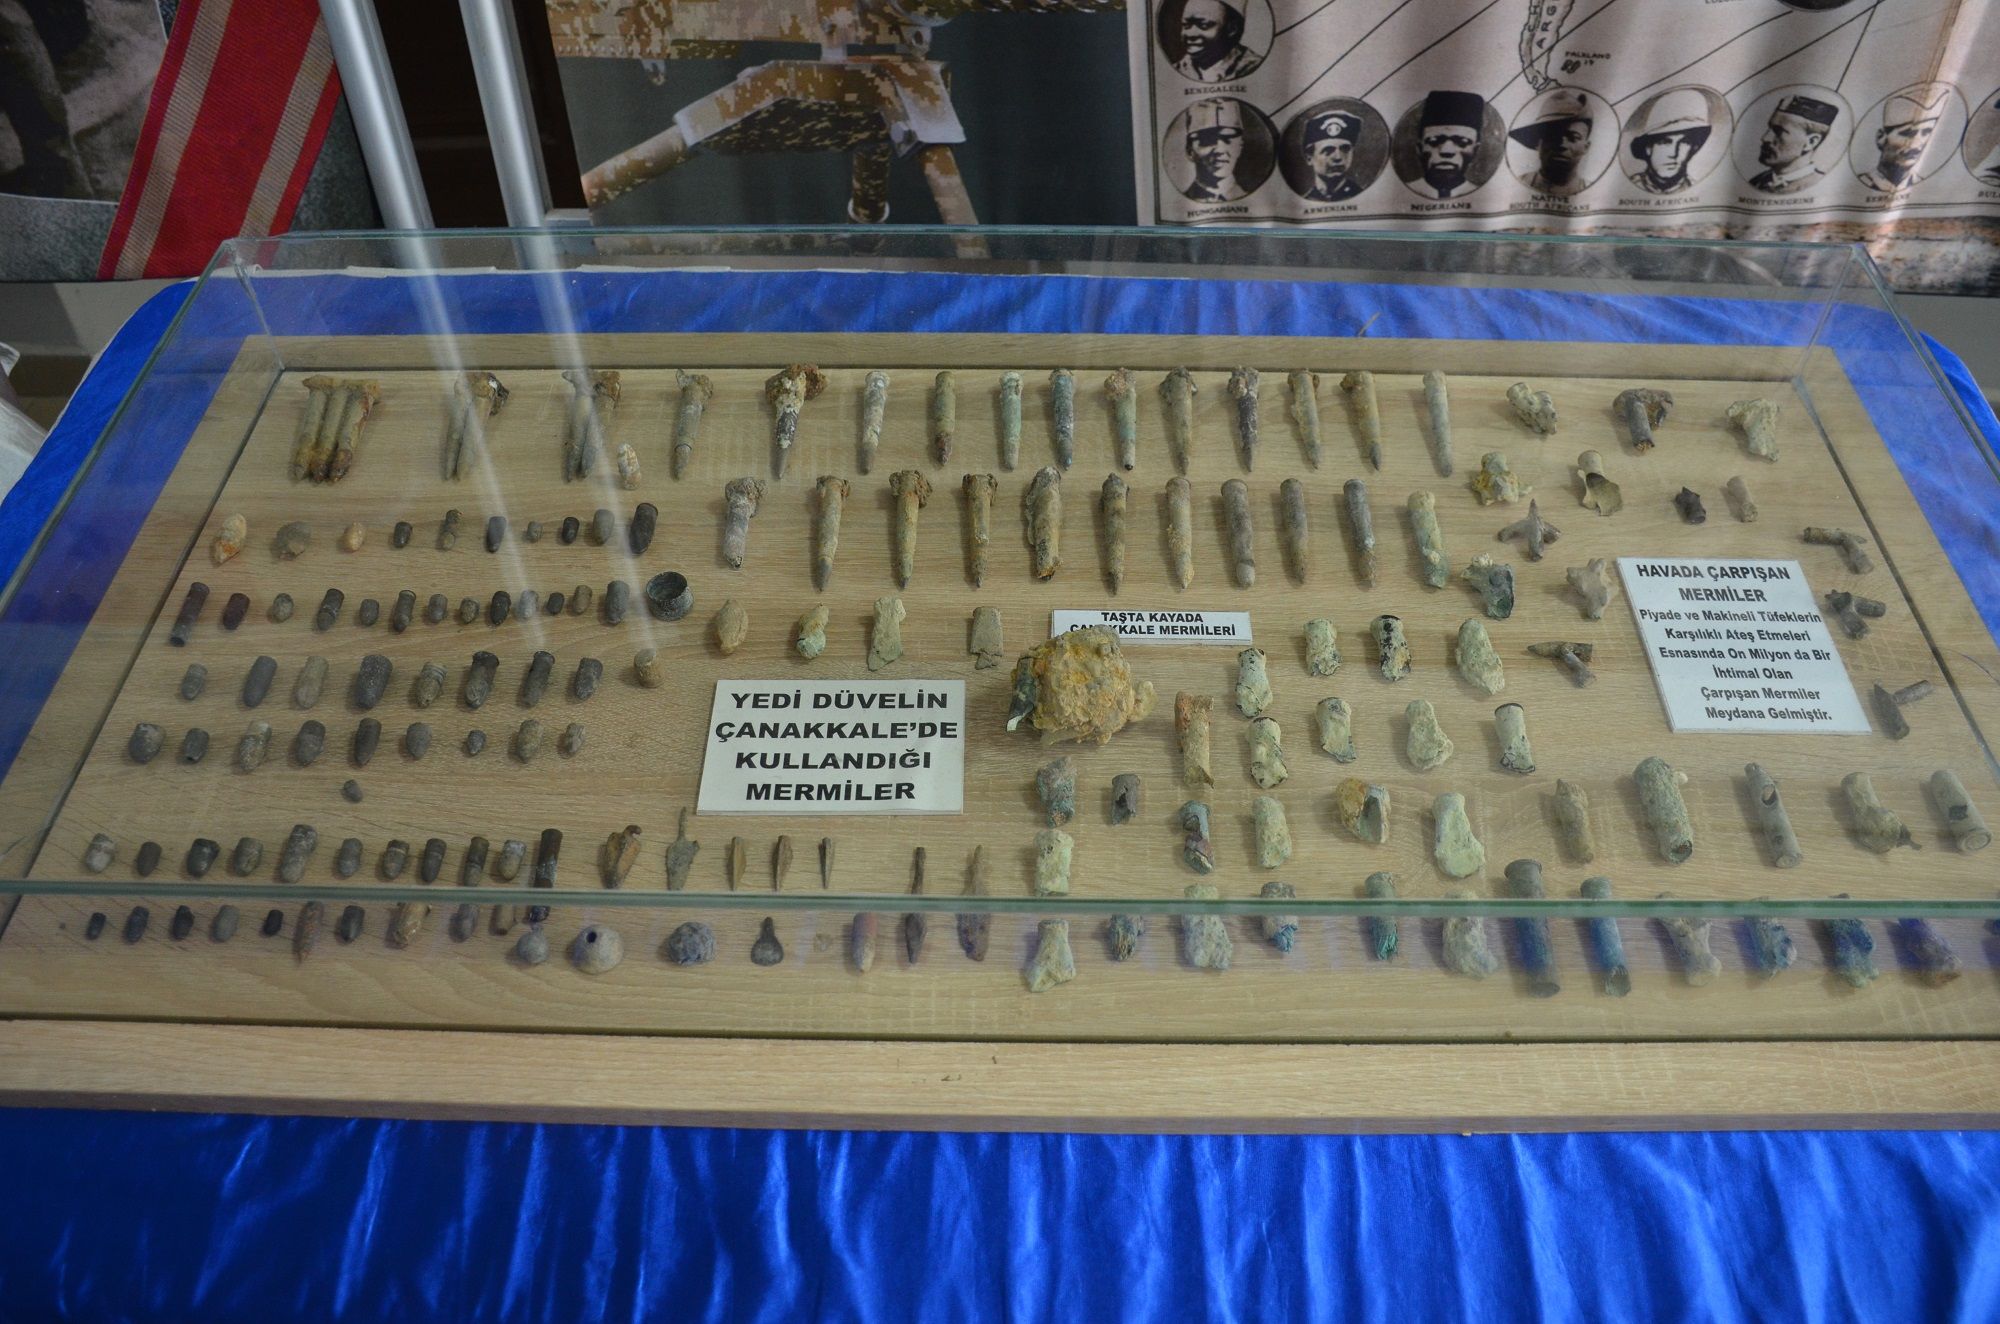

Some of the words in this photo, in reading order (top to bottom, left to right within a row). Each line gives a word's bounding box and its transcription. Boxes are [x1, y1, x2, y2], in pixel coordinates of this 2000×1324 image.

[1184, 85, 1247, 95] SENEGALESE
[1532, 194, 1569, 203] NATIVE
[1655, 196, 1699, 205] AFRICANS
[1738, 197, 1814, 205] MONTENEGRINS
[1187, 205, 1249, 218] HUNGARIANS
[1304, 205, 1358, 214] ARMENIANS
[1410, 202, 1472, 211] NIGERIANS
[1544, 203, 1590, 211] AFRICANS
[1636, 564, 1704, 578] HAVADA
[1707, 565, 1791, 582] ÇARPIŞAN
[1679, 586, 1768, 602] MERMİLER
[1101, 612, 1145, 624] TAŞTA
[1149, 612, 1203, 623] KAYADA
[1640, 609, 1681, 623] Piyade
[1685, 612, 1700, 621] ve
[1704, 610, 1755, 622] Makineli
[1757, 610, 1822, 623] Tüfeklerin
[1159, 623, 1236, 636] MERMİLERİ
[1664, 628, 1722, 641] Karşılıklı
[1726, 629, 1755, 642] Ateş
[1758, 630, 1810, 641] Etmeleri
[1659, 647, 1725, 660] Esnasında
[1728, 648, 1746, 659] On
[1749, 648, 1790, 662] Milyon
[1794, 649, 1810, 660] da
[1813, 650, 1831, 661] Bir
[1714, 665, 1760, 679] İhtimal
[1762, 668, 1793, 679] Olan
[731, 689, 801, 708] YEDİ
[813, 689, 948, 708] DÜVELİN
[1701, 686, 1759, 701] Çarpışan
[1762, 688, 1820, 700] Mermiler
[1705, 706, 1765, 721] Meydana
[1768, 707, 1832, 722] Gelmiştir.
[715, 722, 958, 743] ÇANAKKALE’DE
[735, 748, 931, 769] KULLANDIĞI
[746, 780, 916, 801] MERMİLER
